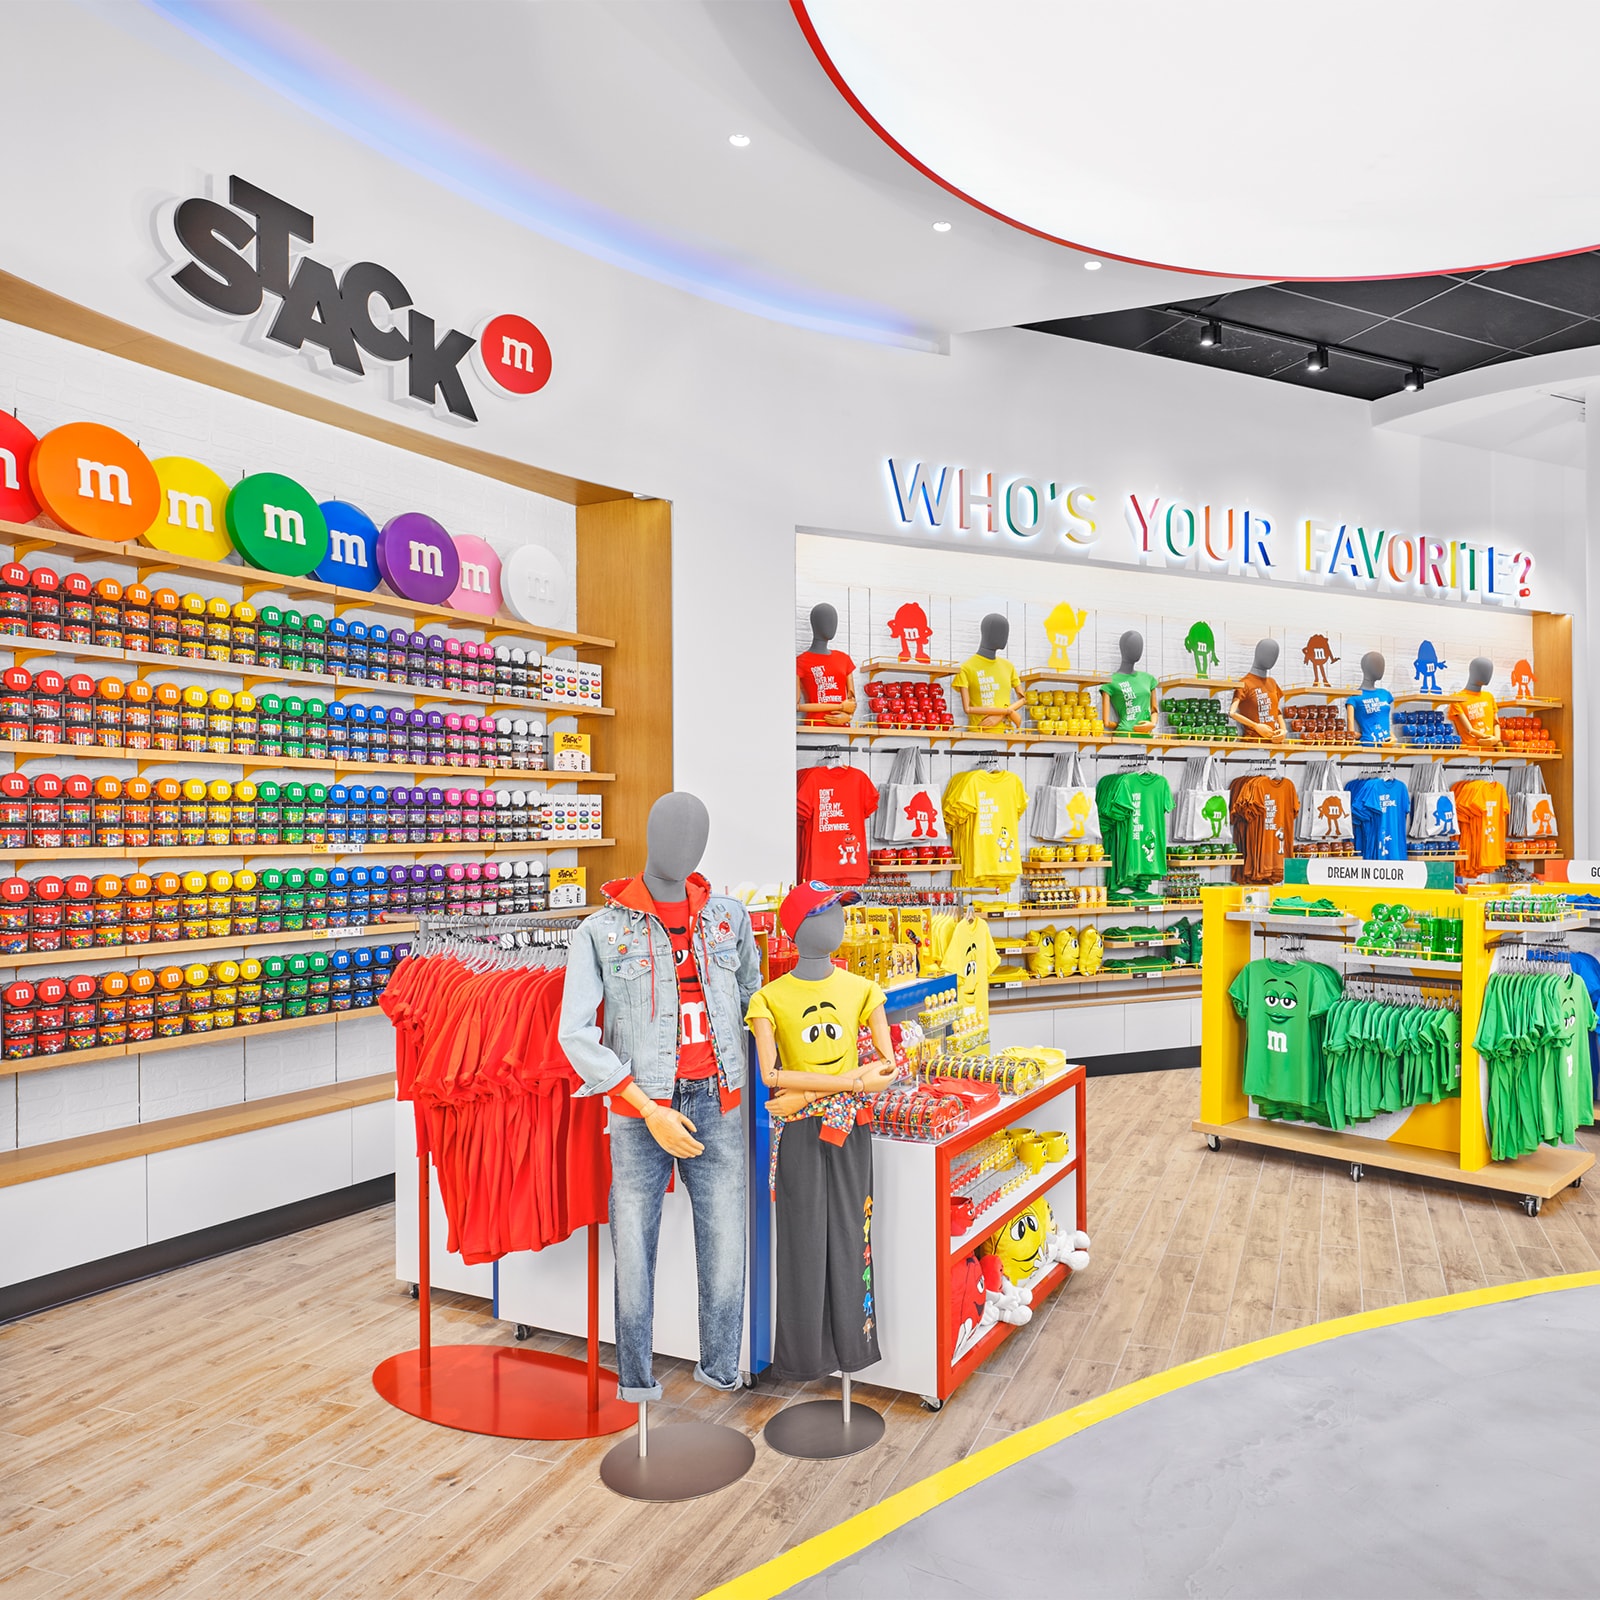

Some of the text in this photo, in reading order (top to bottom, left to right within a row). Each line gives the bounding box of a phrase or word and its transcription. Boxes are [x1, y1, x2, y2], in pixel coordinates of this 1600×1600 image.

[171, 174, 534, 422] STACK m
[76, 457, 132, 506] m
[167, 489, 214, 532] m
[263, 503, 306, 546] m
[887, 458, 1536, 597] WHO'S YOUR FAVORITE?
[330, 530, 368, 568] m
[409, 540, 444, 578] m
[460, 560, 491, 594] m
[903, 627, 920, 642] m
[916, 810, 928, 822] m
[1328, 806, 1340, 816] m
[1328, 866, 1404, 881] DREAM IN COLOR
[1266, 1029, 1288, 1053] m
